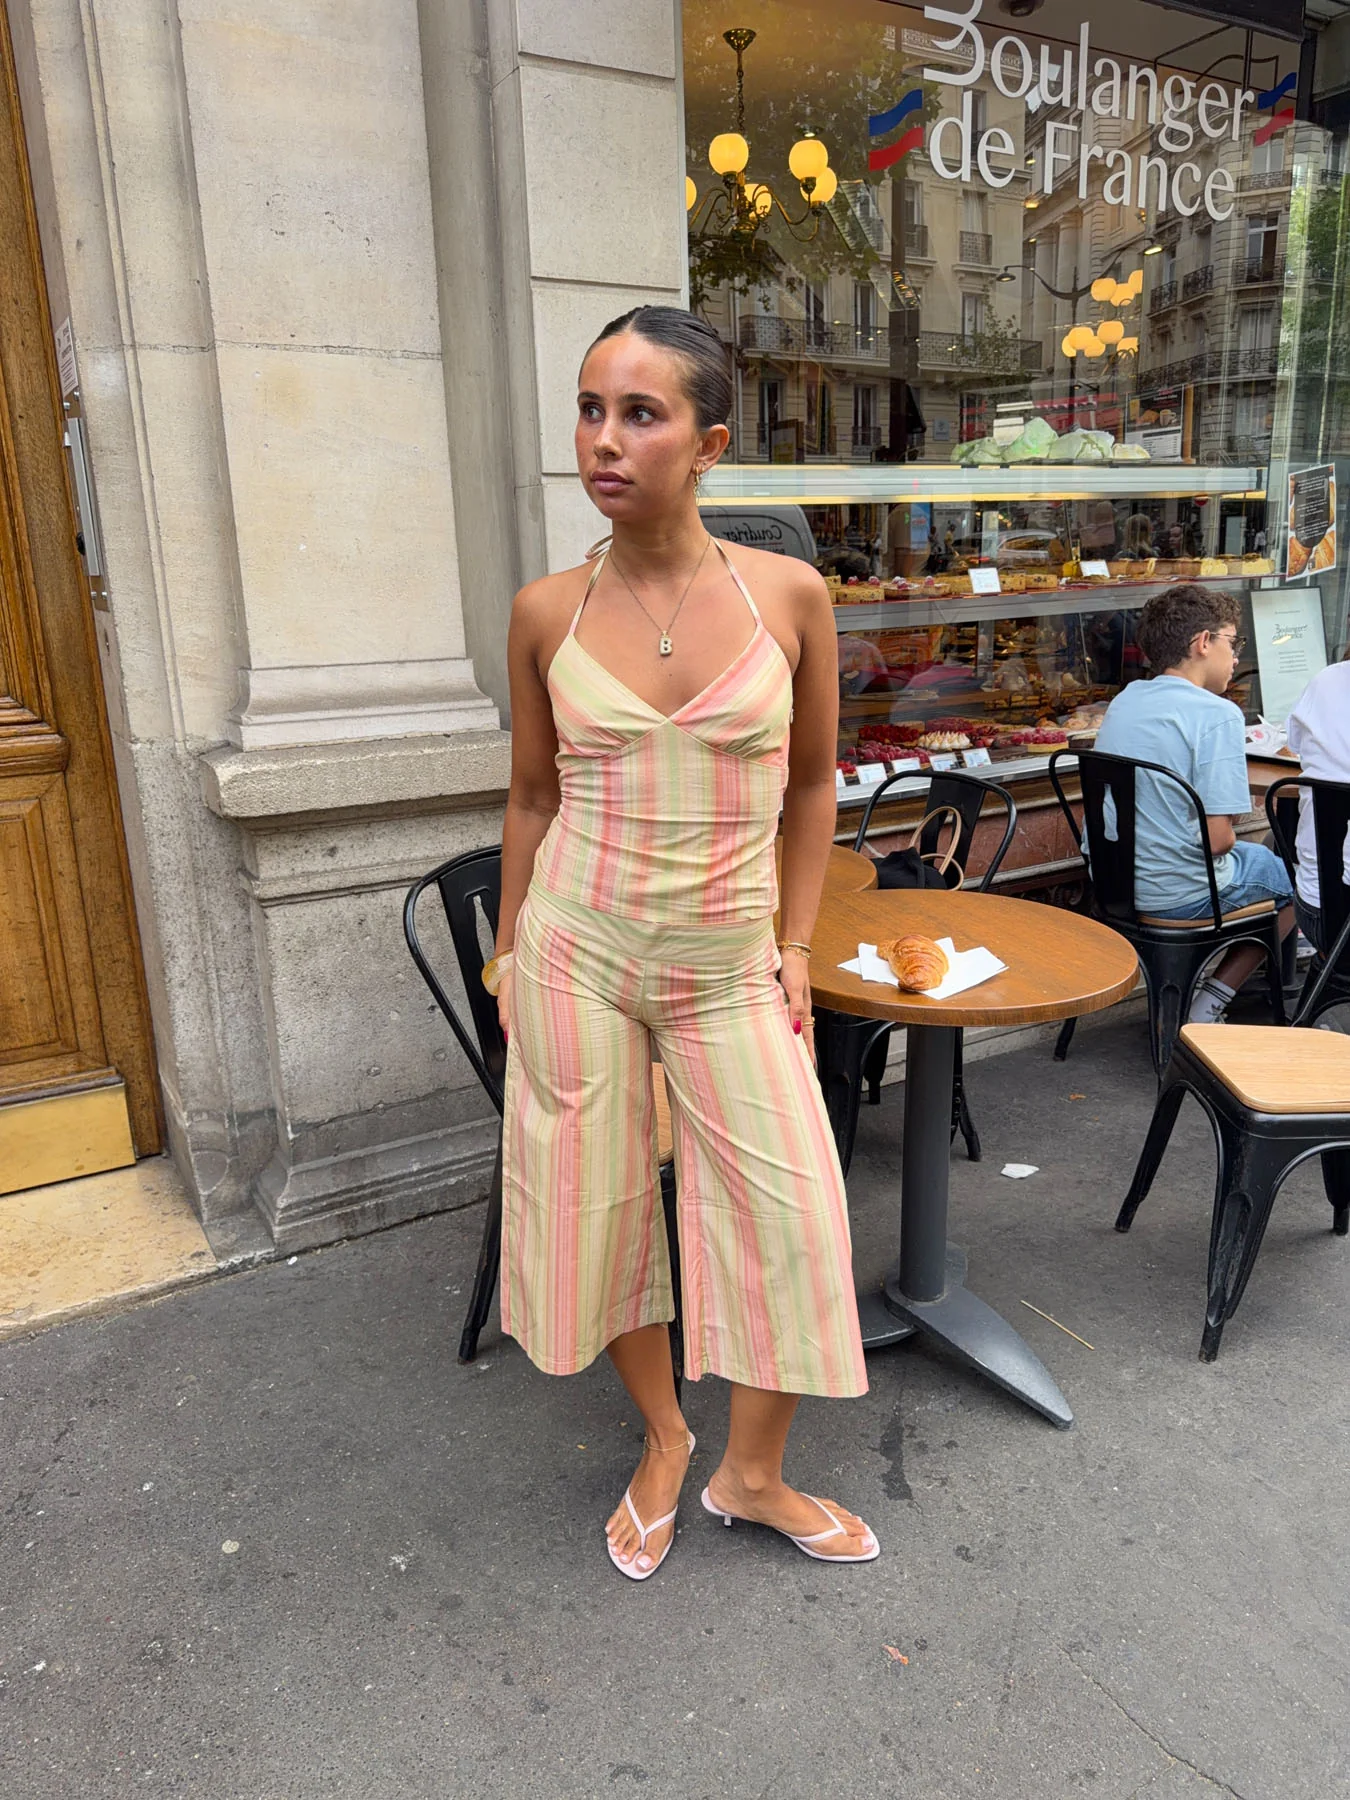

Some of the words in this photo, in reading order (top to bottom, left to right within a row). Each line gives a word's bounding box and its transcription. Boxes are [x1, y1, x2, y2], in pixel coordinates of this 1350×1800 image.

[923, 0, 1255, 152] Boulanger
[930, 91, 1015, 188] de
[1044, 121, 1235, 221] France
[659, 637, 673, 657] B
